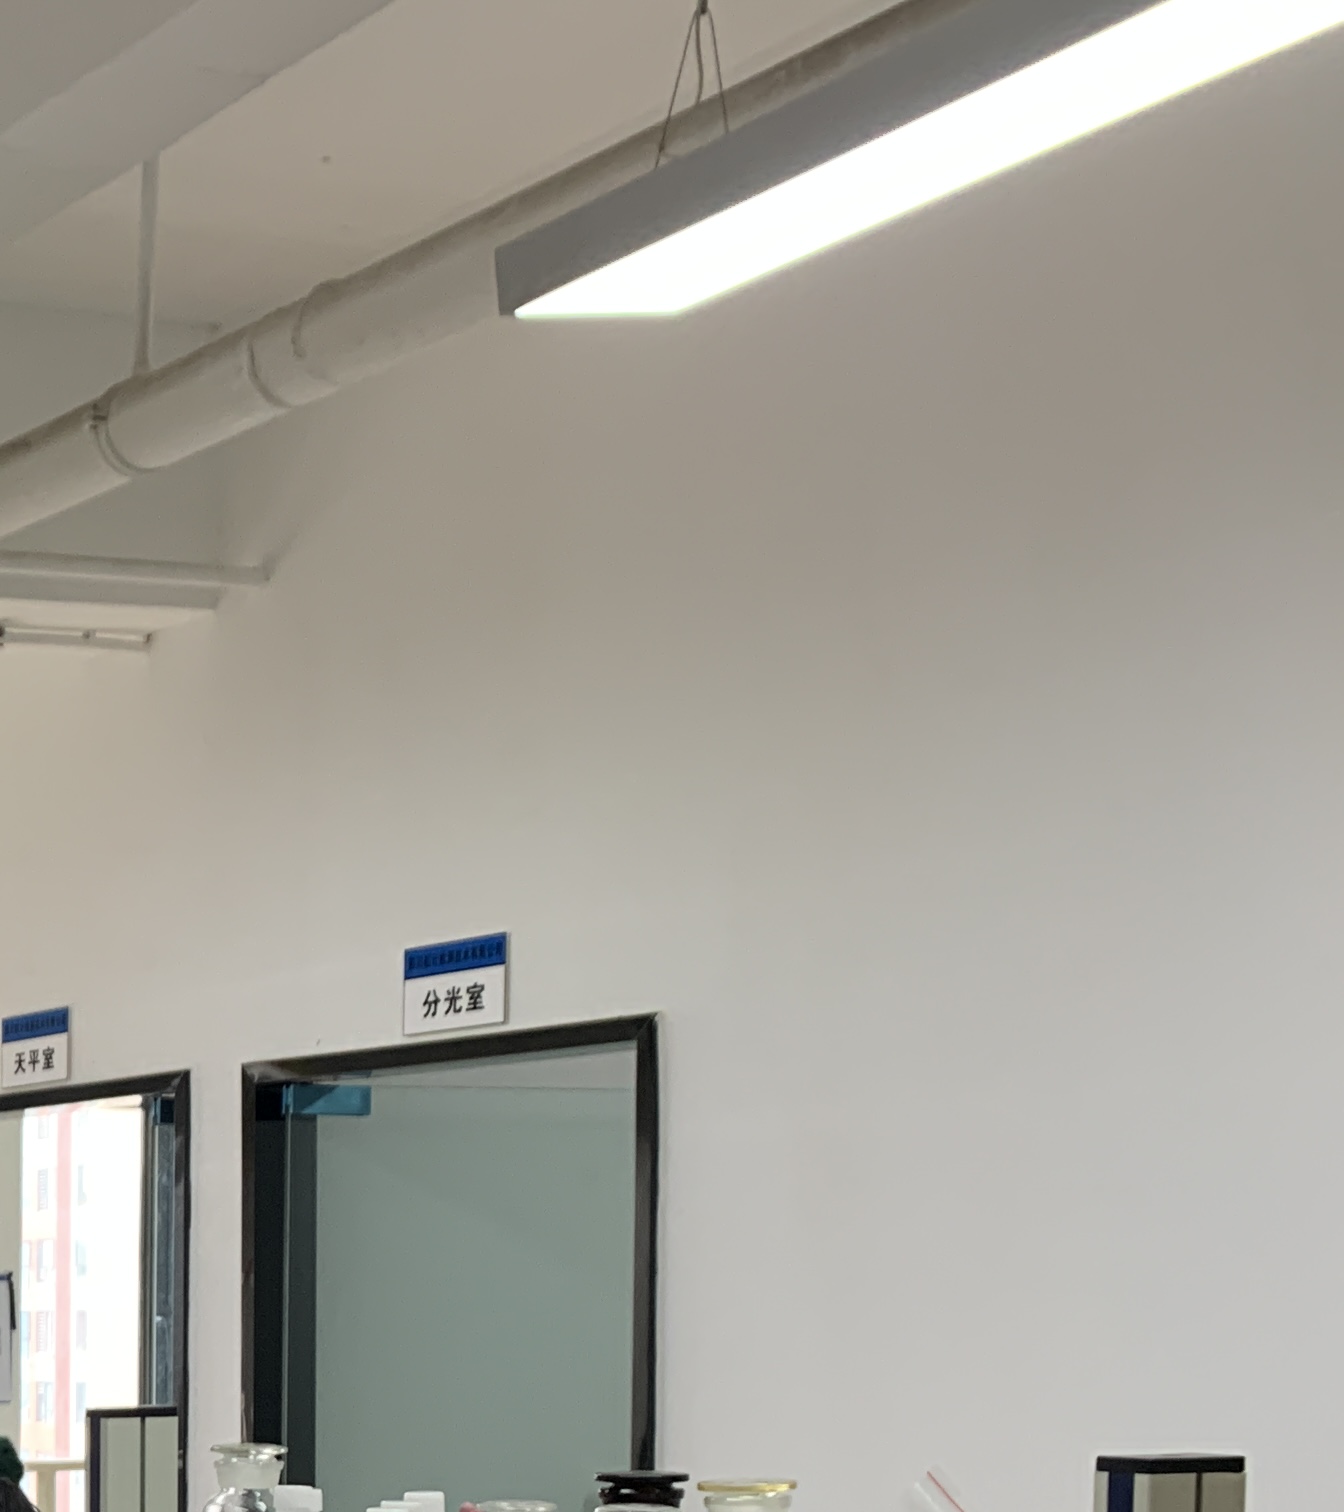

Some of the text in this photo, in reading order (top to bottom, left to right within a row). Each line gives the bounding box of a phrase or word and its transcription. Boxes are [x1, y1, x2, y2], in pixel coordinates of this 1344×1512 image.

[422, 982, 485, 1019] 分光室
[14, 1046, 55, 1075] 天平室
